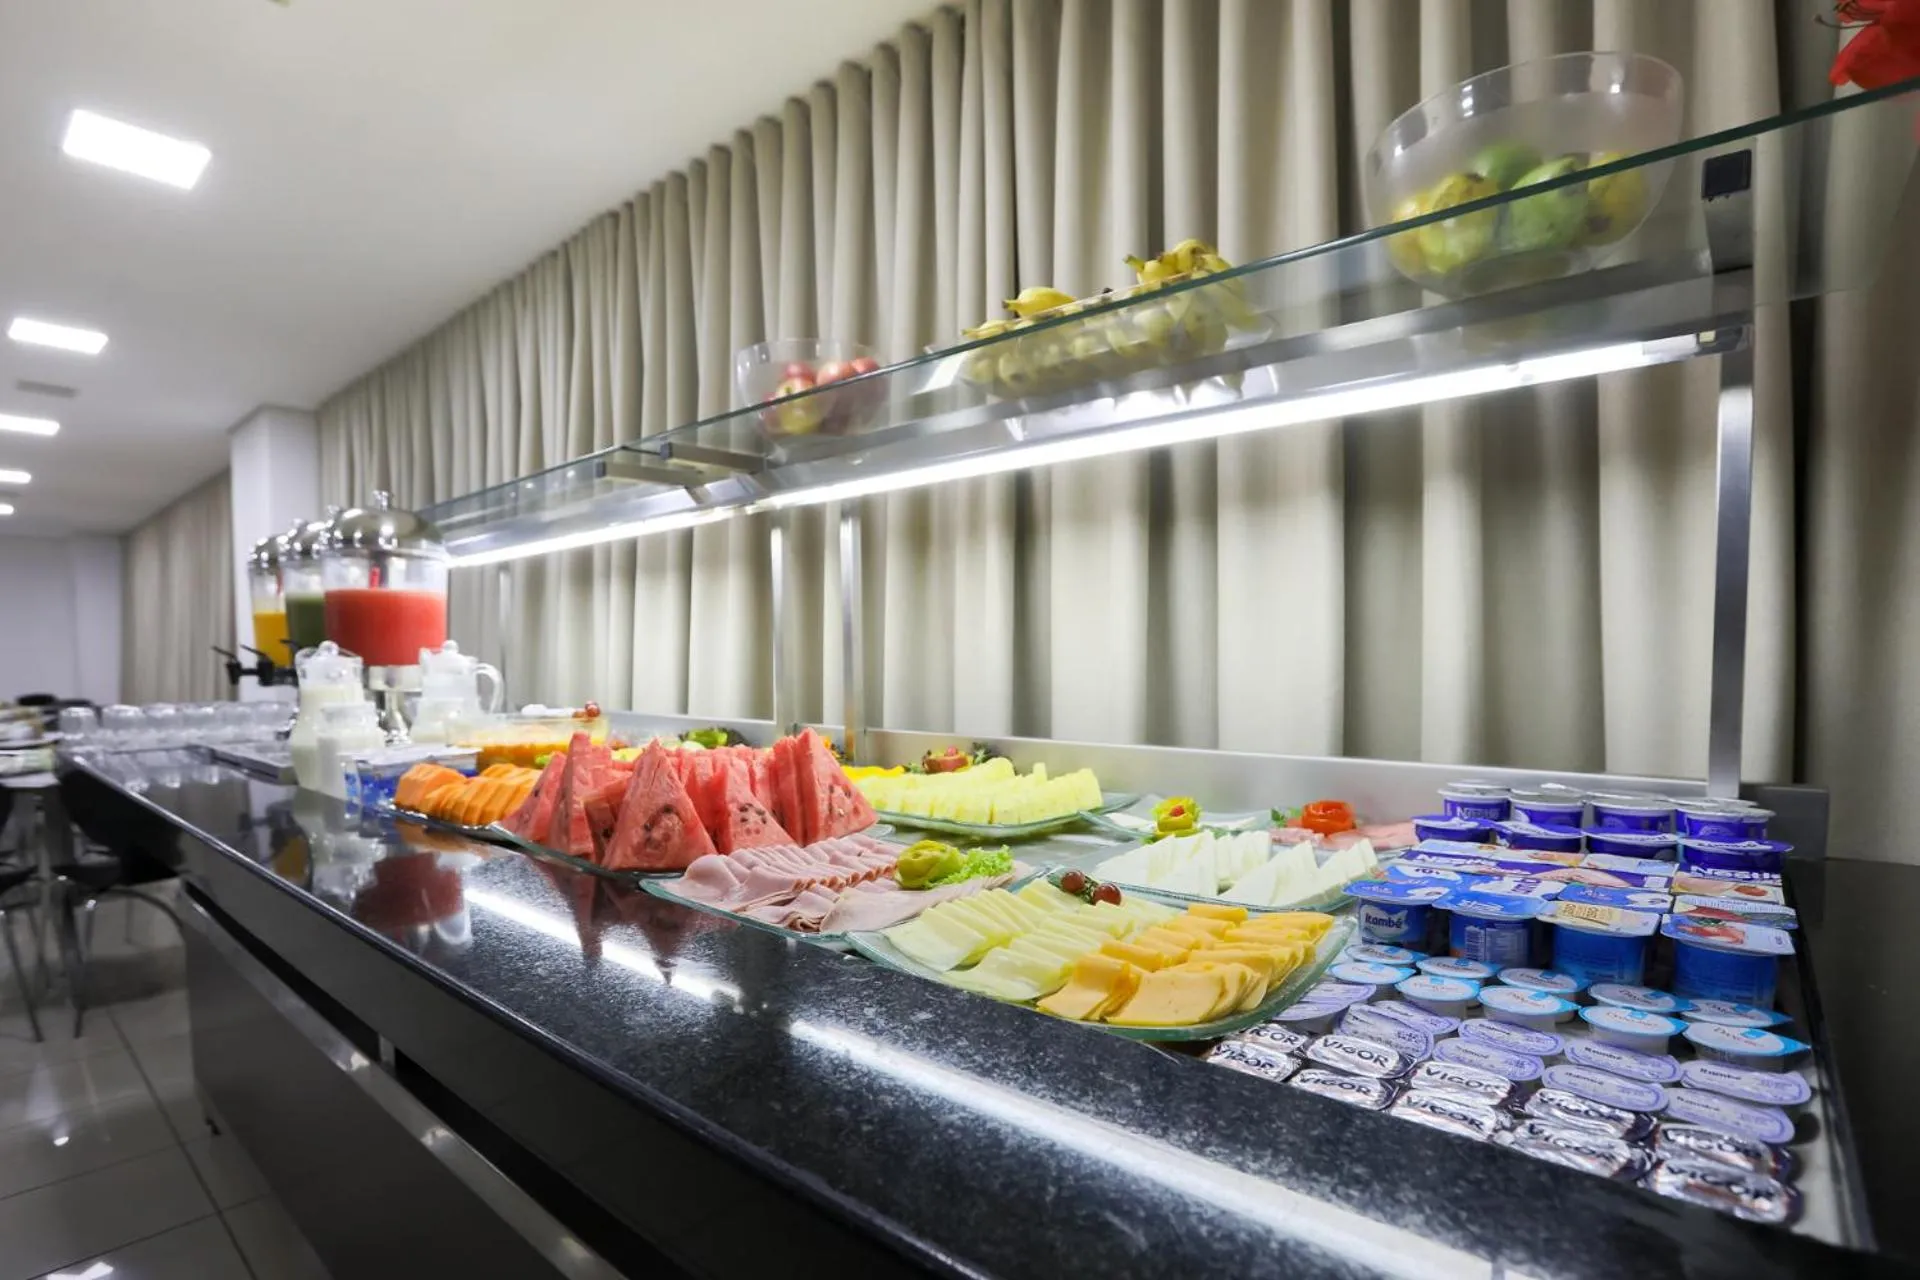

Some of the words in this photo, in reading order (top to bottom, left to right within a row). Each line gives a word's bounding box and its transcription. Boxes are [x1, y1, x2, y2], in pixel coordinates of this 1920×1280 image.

[1364, 912, 1403, 929] Itambé
[1322, 1038, 1390, 1068] VIGOR
[1299, 1075, 1372, 1096] VIGOR
[1404, 1096, 1485, 1131] VIGOR
